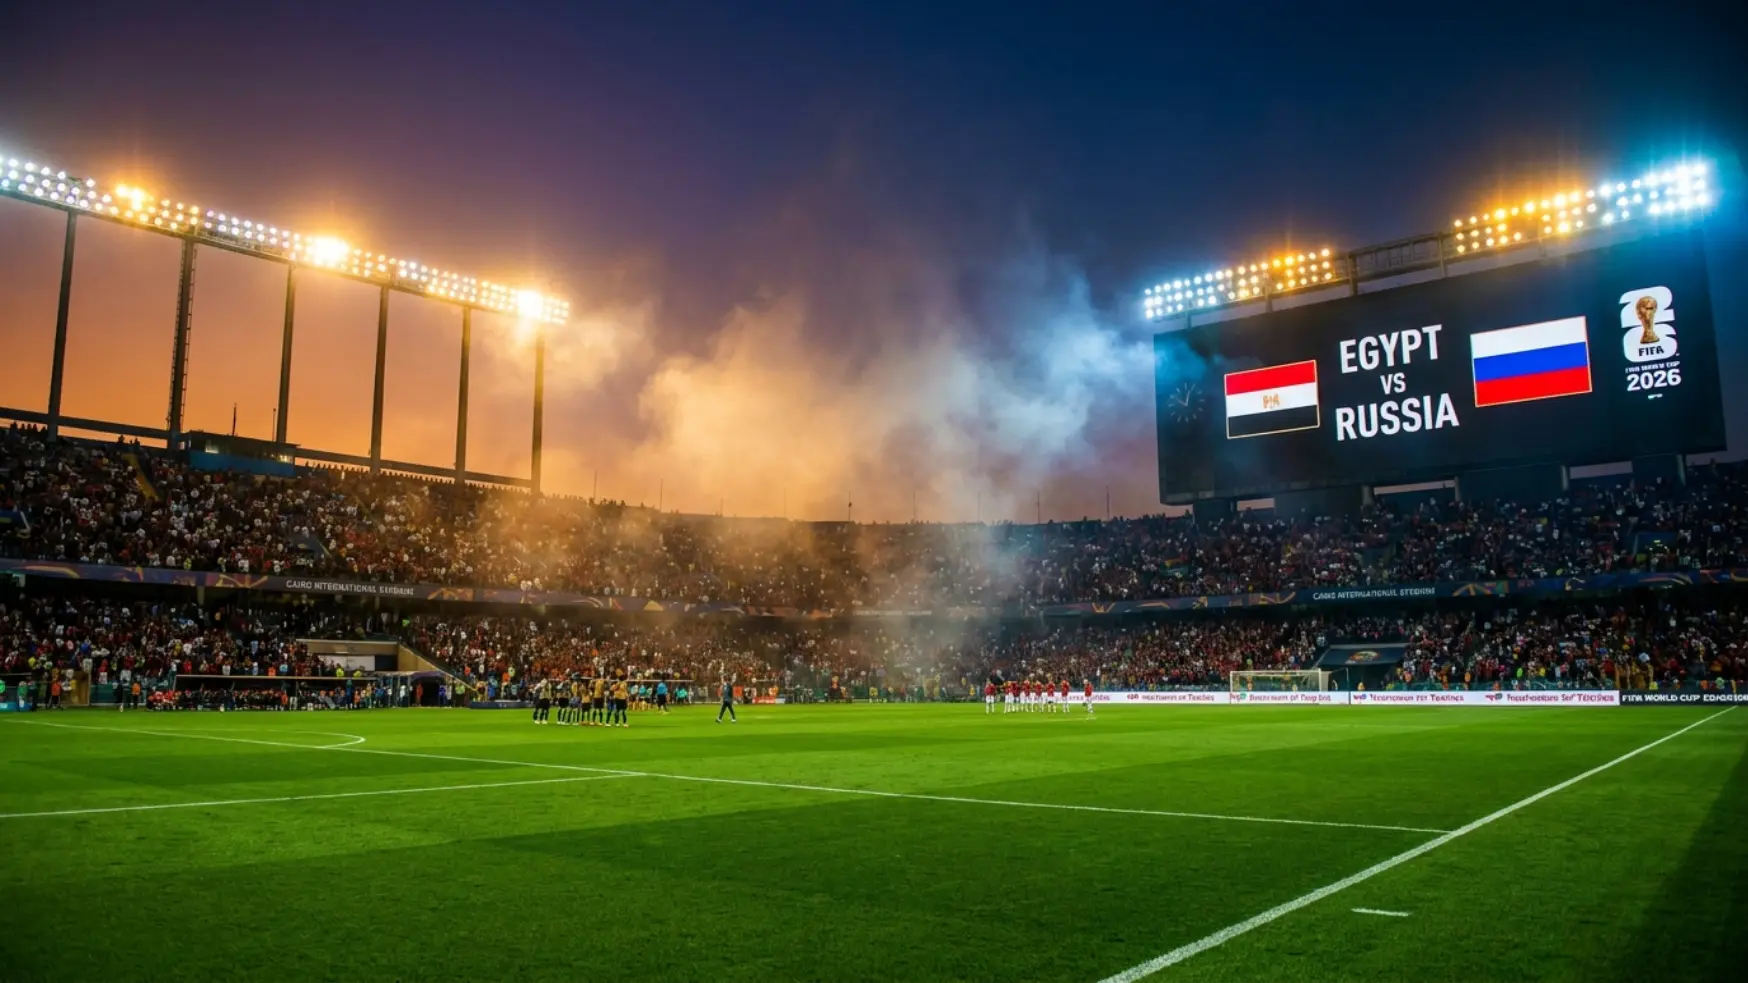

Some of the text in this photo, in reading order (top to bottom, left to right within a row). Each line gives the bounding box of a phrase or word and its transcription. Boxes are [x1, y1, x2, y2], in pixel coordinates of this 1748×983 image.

[1340, 324, 1442, 373] EGYPT
[1638, 345, 1665, 357] FIFA
[1380, 372, 1406, 395] VS
[1626, 368, 1682, 391] 2026
[1335, 393, 1460, 441] RUSSIA
[1679, 694, 1700, 702] CUP
